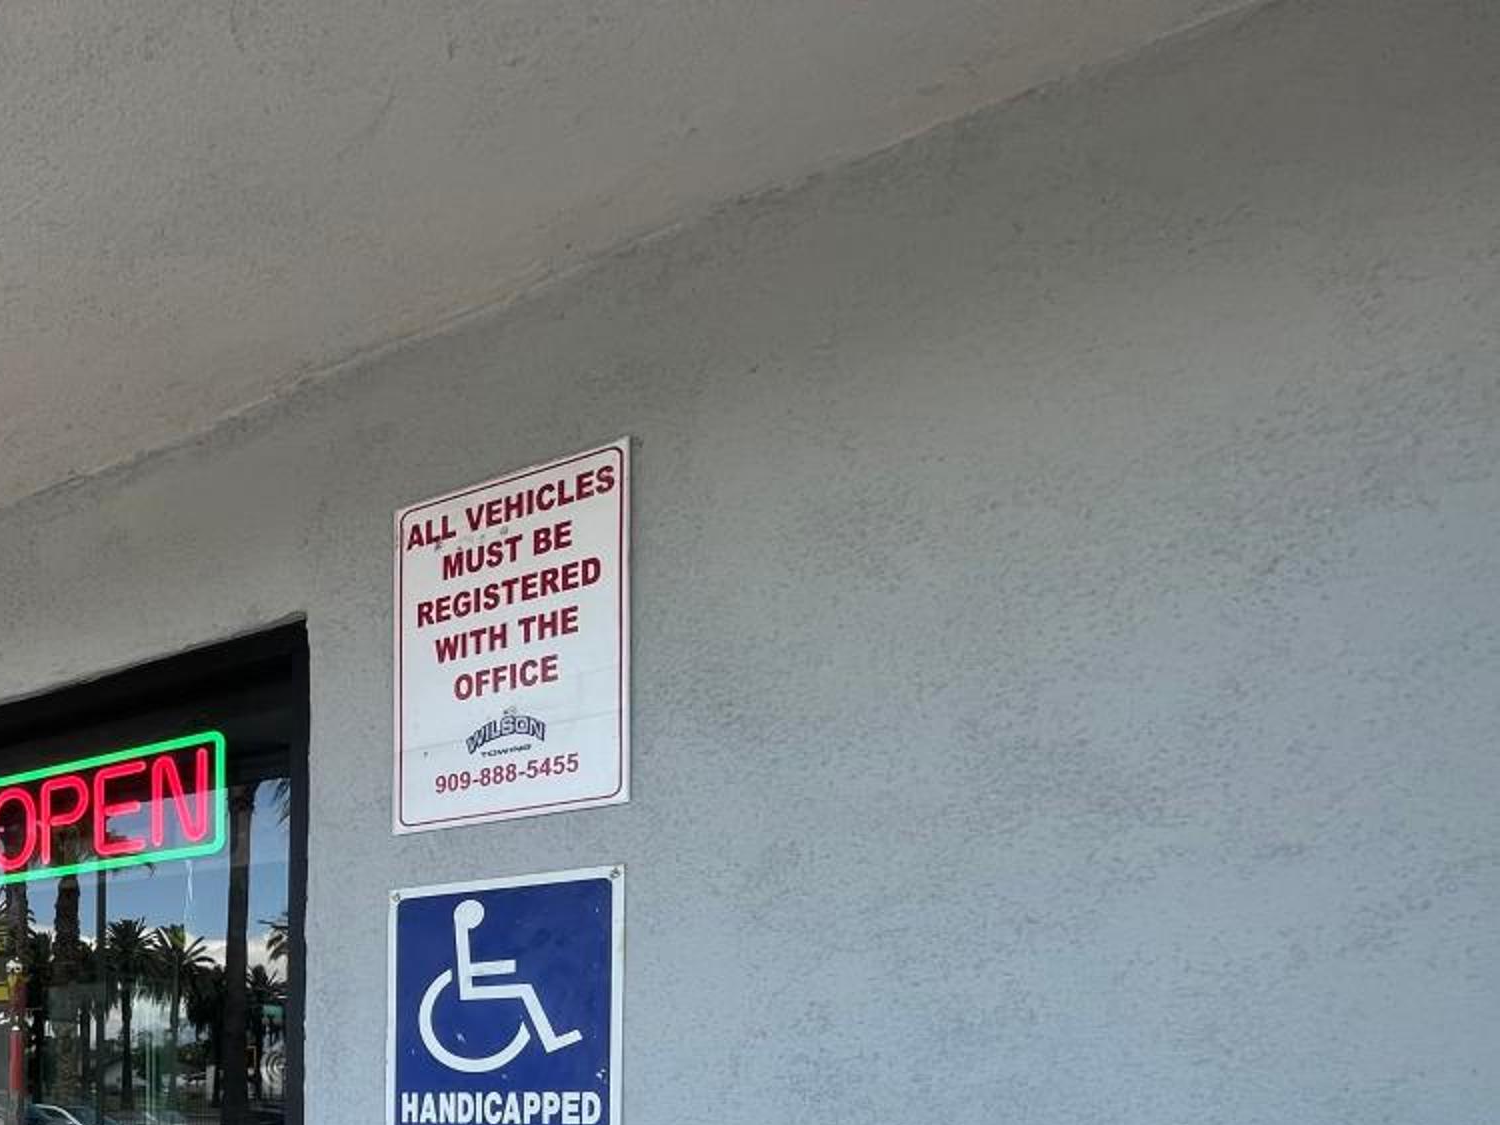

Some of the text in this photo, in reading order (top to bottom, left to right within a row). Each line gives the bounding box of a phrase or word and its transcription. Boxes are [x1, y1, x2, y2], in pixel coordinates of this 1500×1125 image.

[407, 465, 615, 551] ALL VEHICLES
[443, 520, 573, 581] MUST BE
[417, 557, 601, 628] REGISTERED
[435, 606, 579, 664] WITH THE
[454, 654, 558, 701] OFFICE
[466, 714, 546, 754] WILSON
[435, 752, 579, 794] 909-888-5455
[401, 1091, 601, 1125] HANDICAPPED
